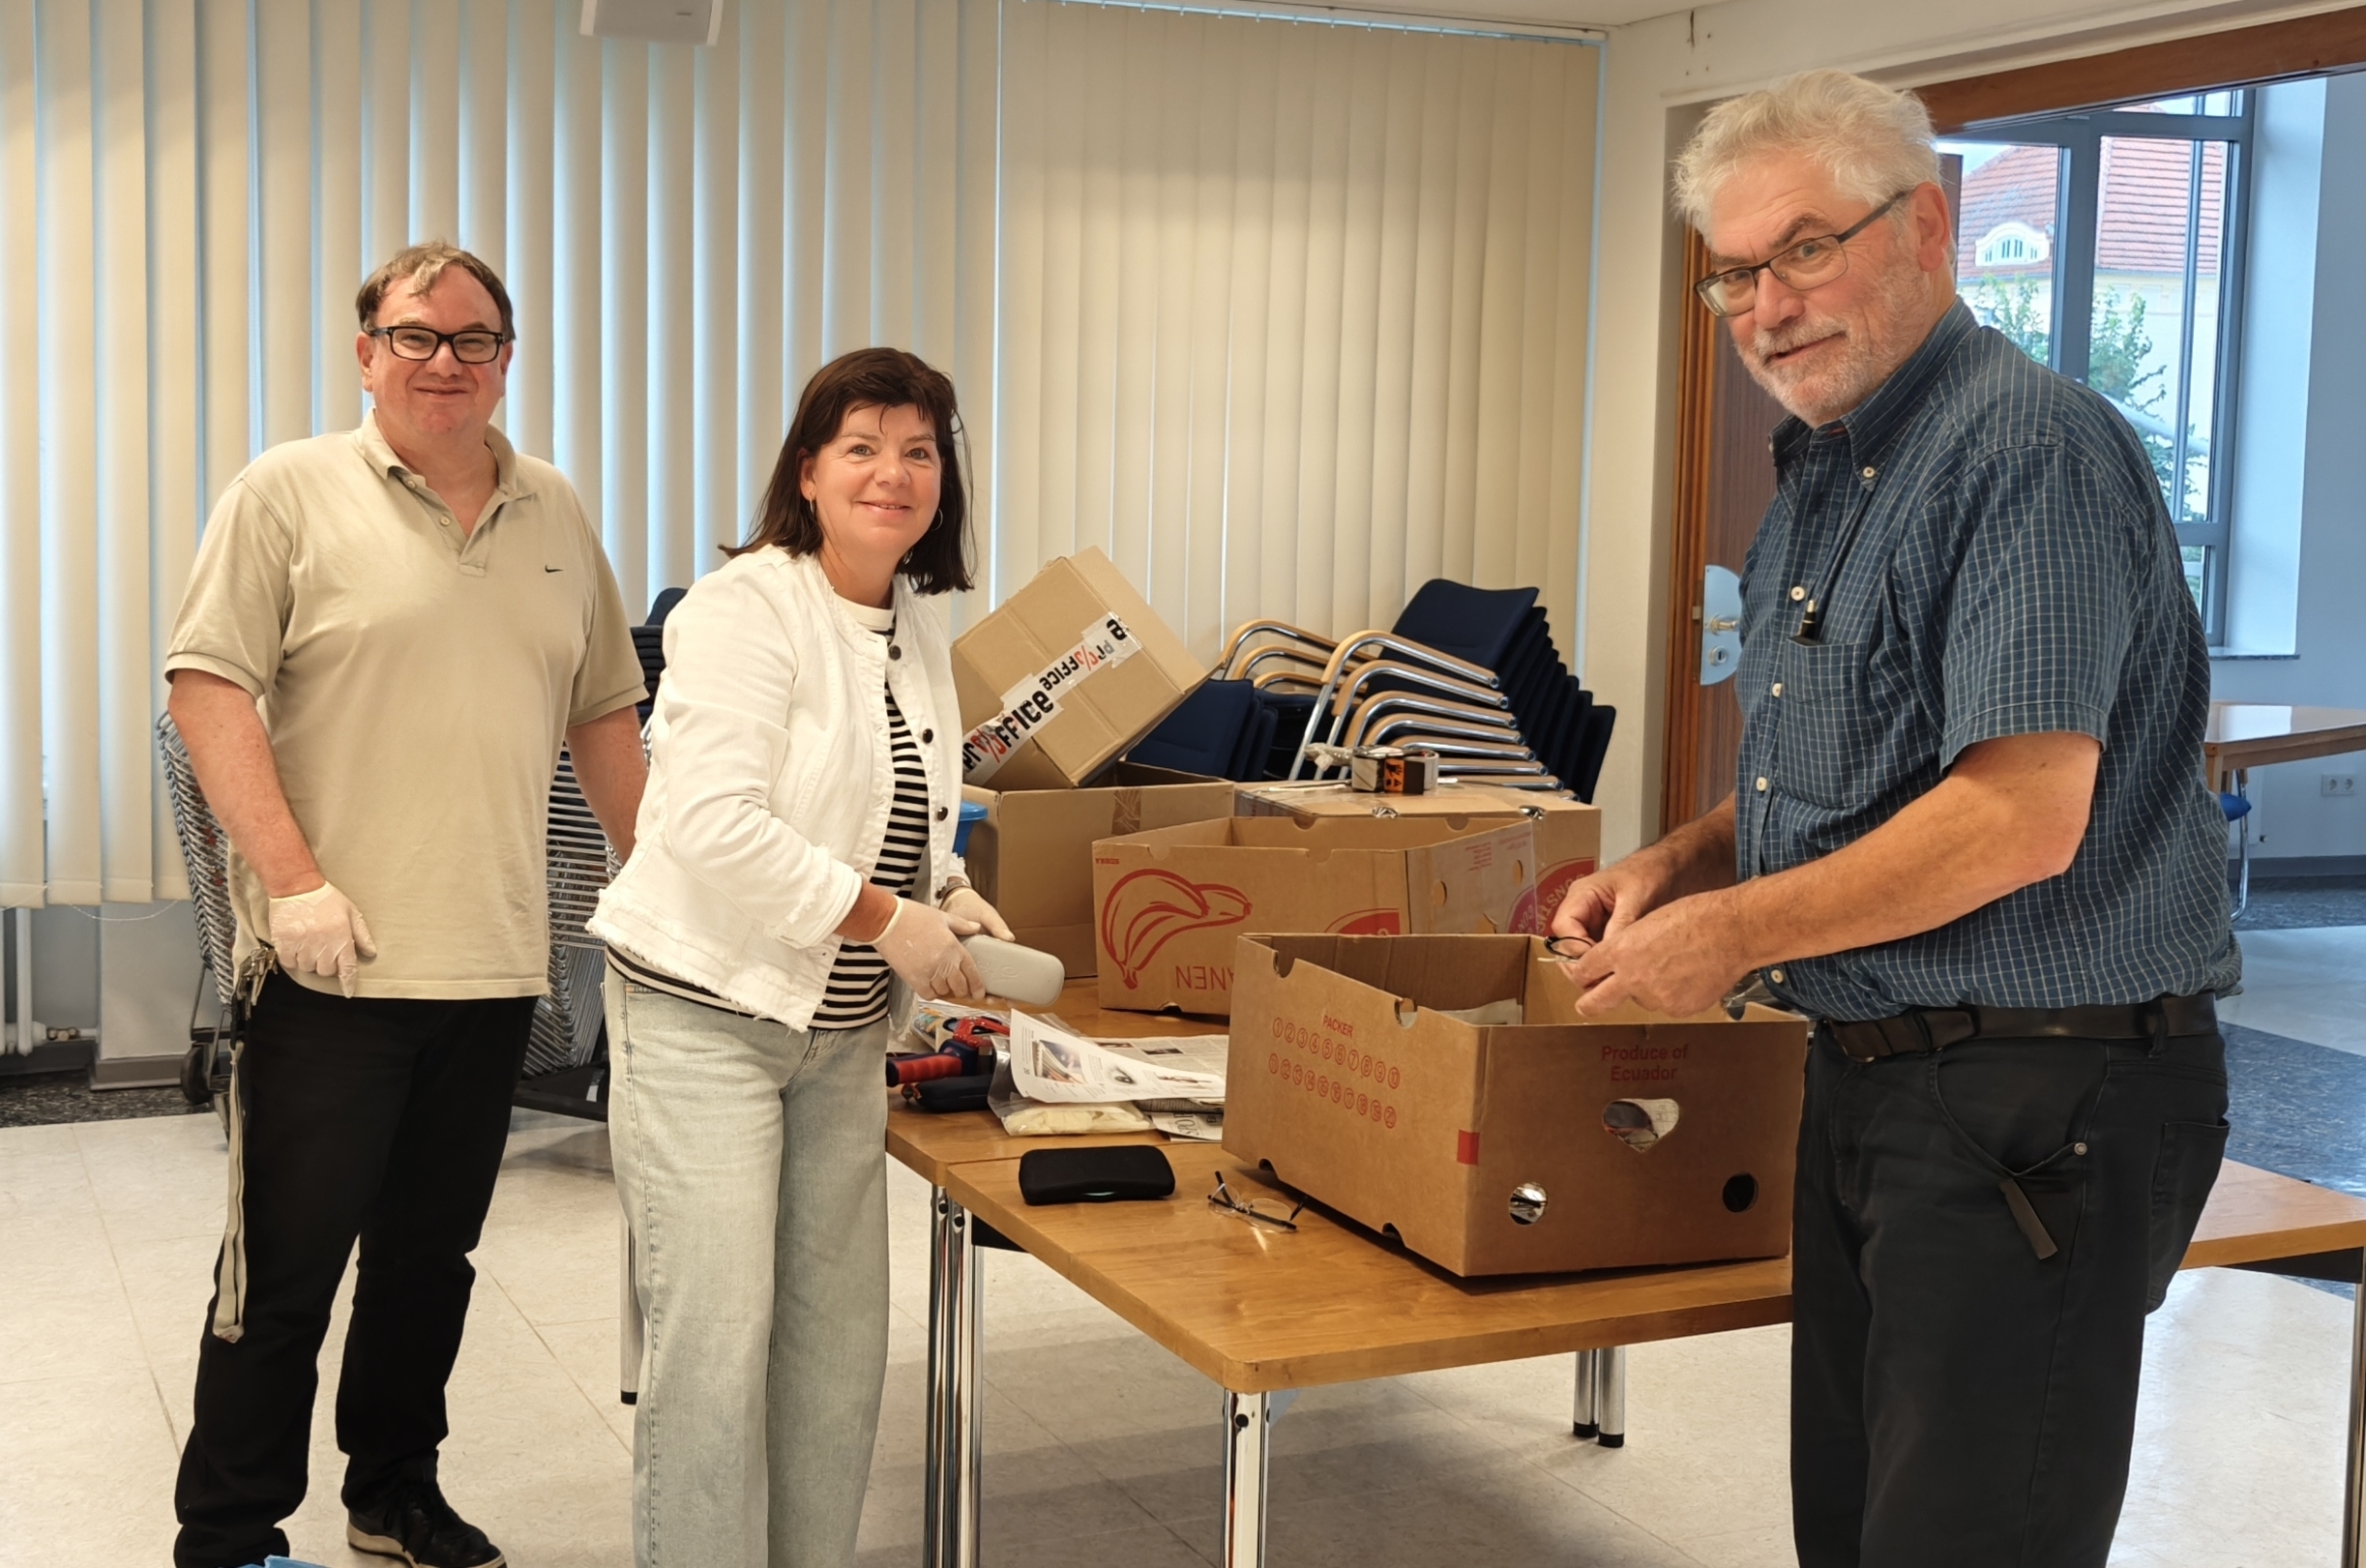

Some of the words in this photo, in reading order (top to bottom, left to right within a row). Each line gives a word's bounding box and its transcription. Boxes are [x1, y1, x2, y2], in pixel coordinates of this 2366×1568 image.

[1323, 1014, 1353, 1038] PACKER
[1602, 1045, 1668, 1060] Produce
[1672, 1043, 1690, 1059] of
[1611, 1065, 1678, 1081] Ecuador
